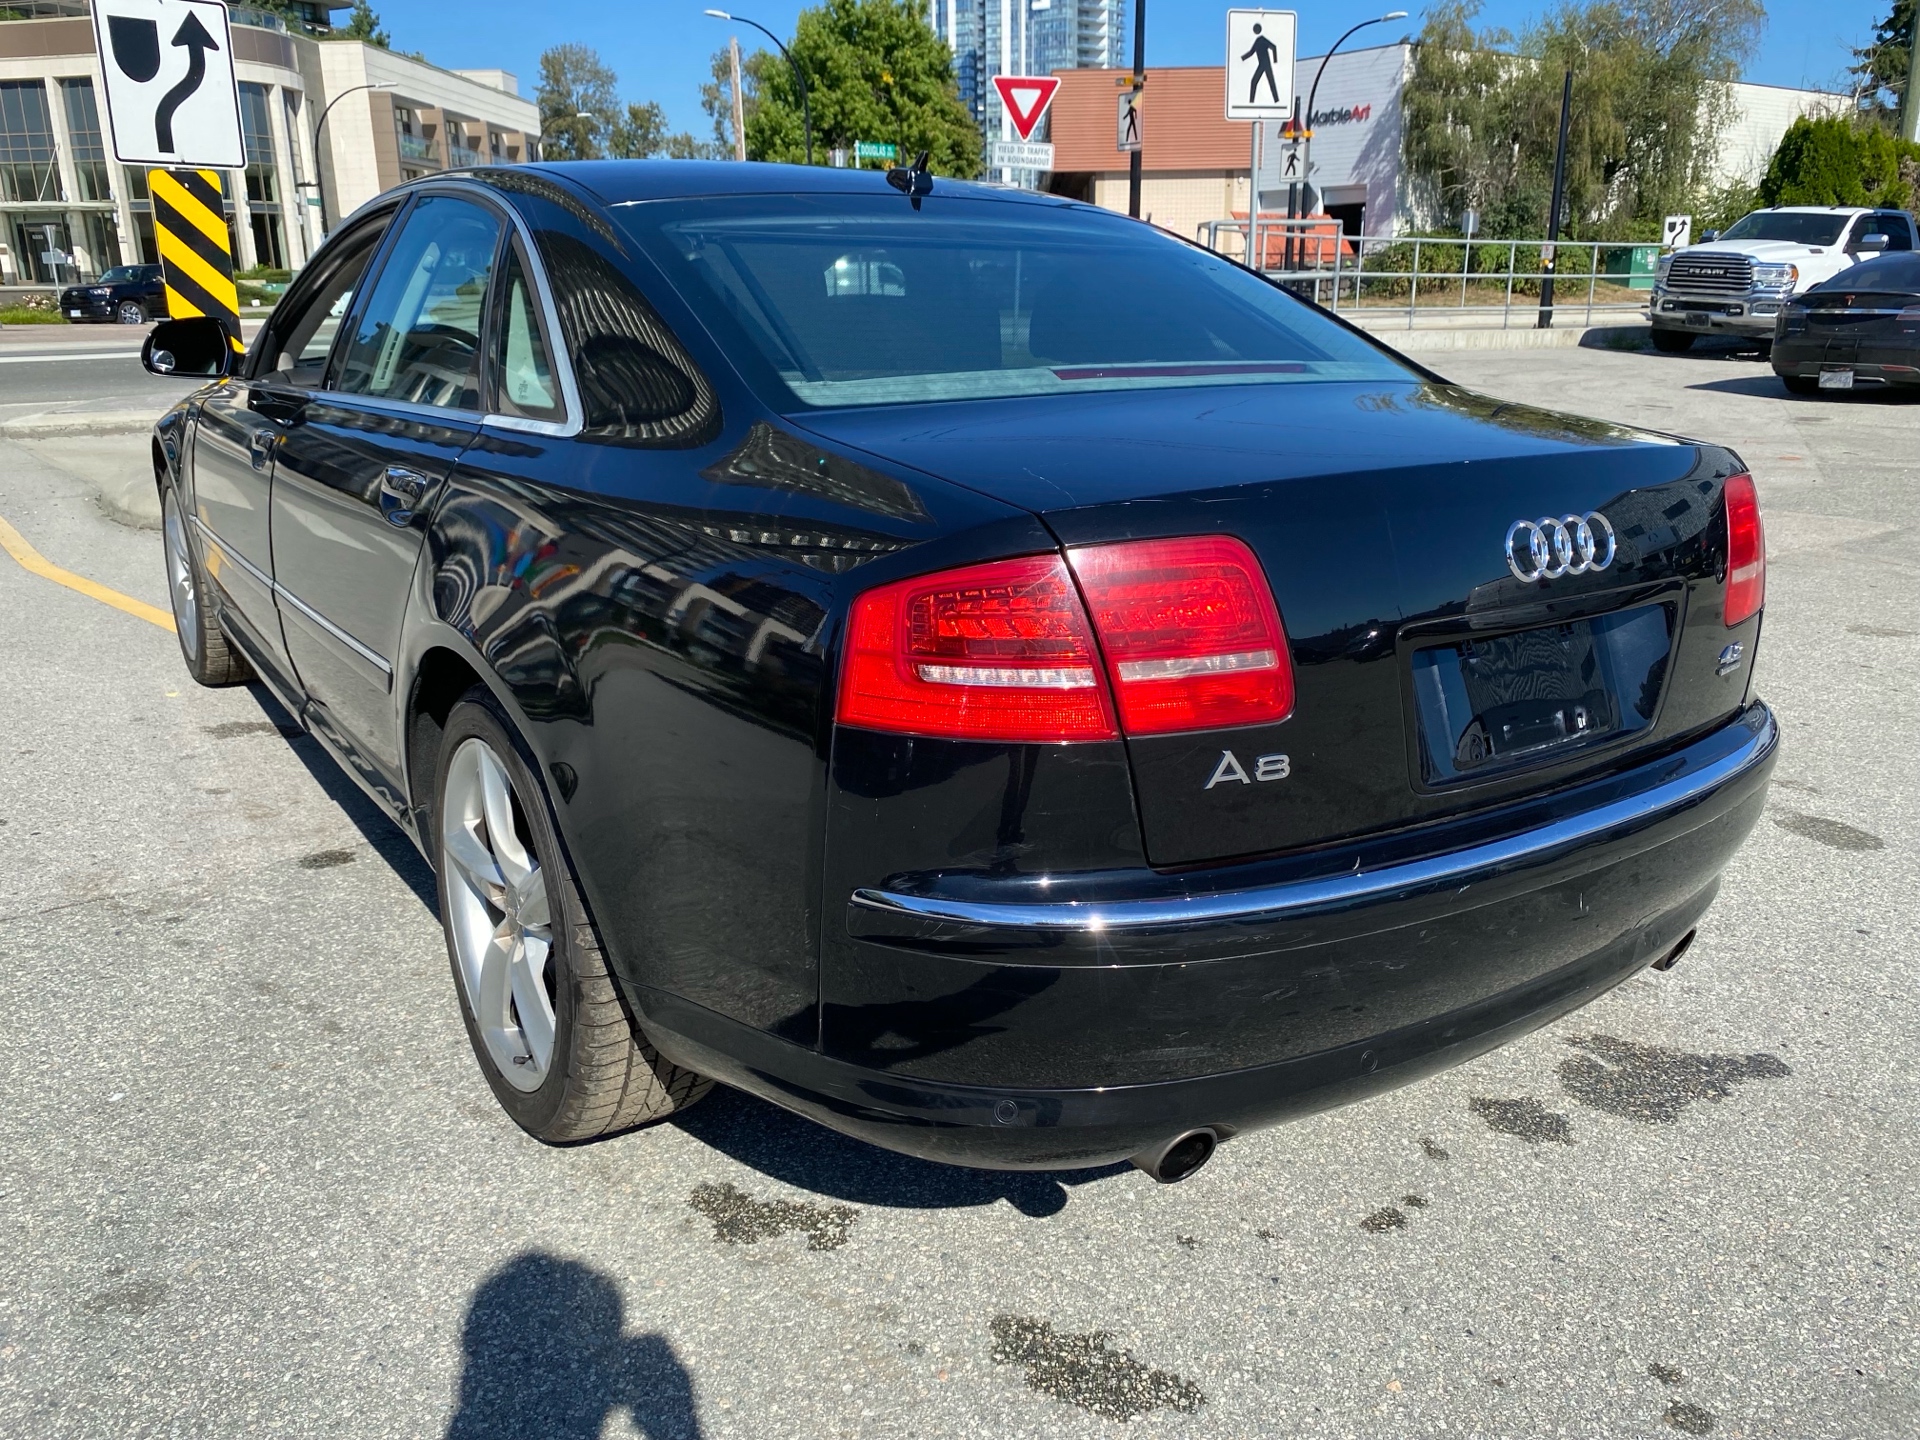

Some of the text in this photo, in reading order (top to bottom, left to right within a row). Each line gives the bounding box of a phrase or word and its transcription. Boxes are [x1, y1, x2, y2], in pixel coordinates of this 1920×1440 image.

[860, 144, 886, 157] DOUGLAS
[997, 145, 1050, 156] YIELD TO TRAFFIC
[997, 155, 1050, 166] IN ROUNDABOUT
[1688, 267, 1726, 275] RAM
[1203, 748, 1291, 790] A8
